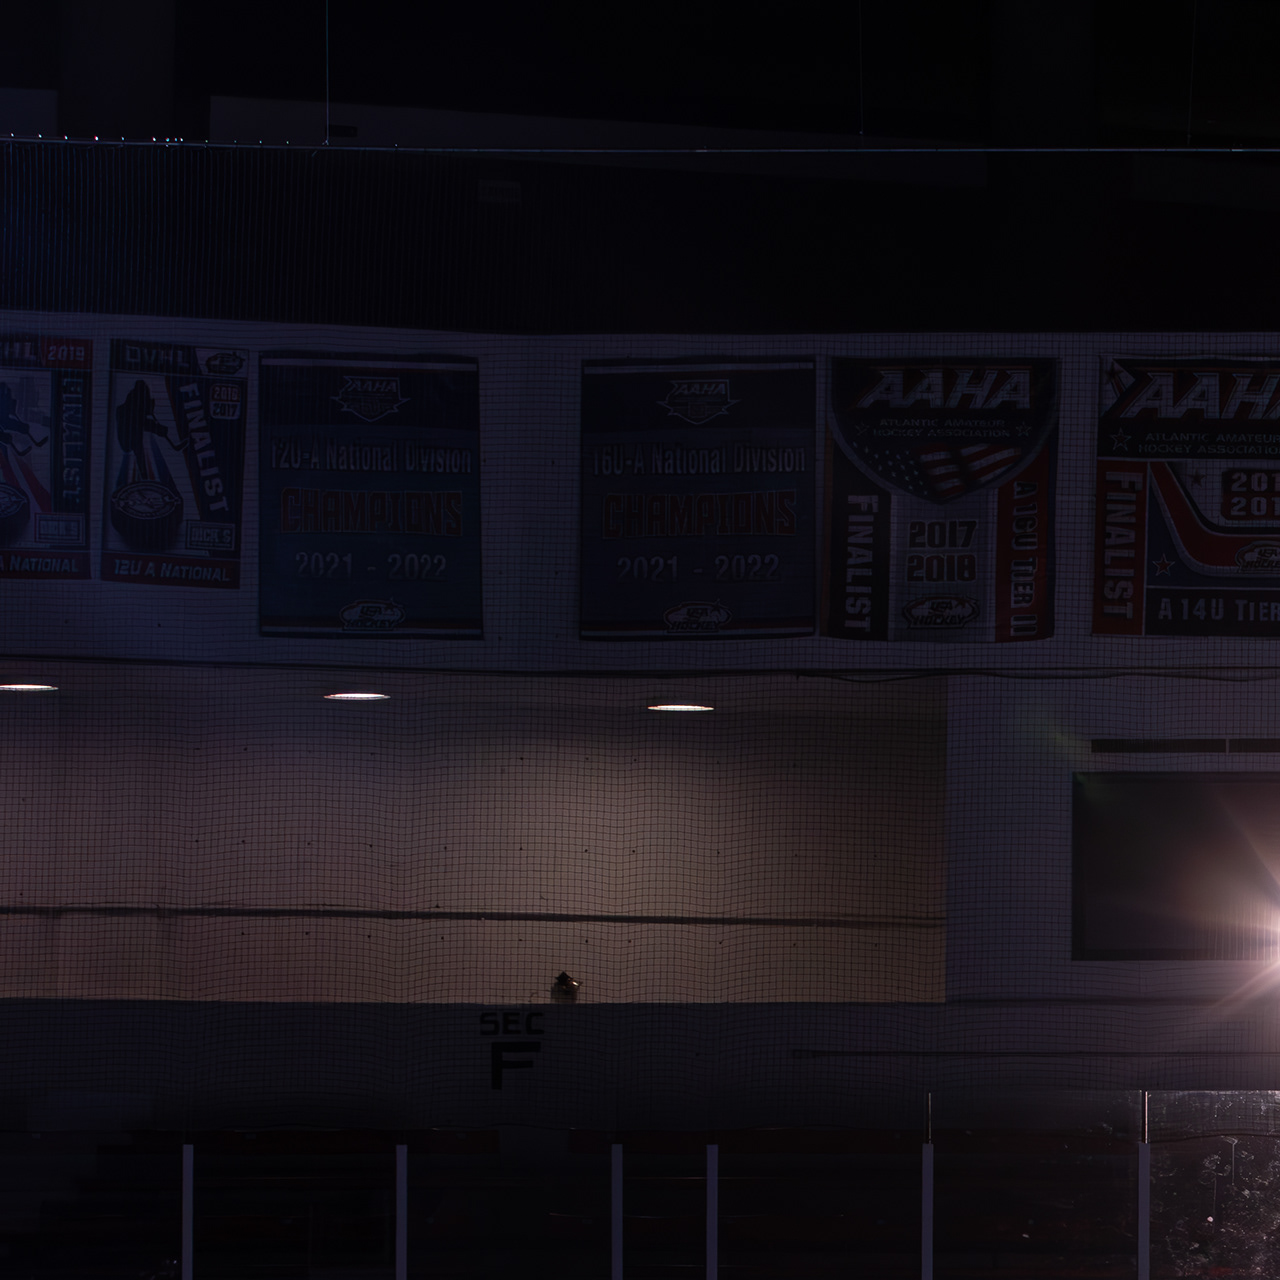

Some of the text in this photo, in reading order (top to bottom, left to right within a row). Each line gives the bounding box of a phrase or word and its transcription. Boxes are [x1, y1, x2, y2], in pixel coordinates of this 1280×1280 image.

[856, 368, 1031, 409] AAHA
[873, 429, 1011, 438] HOCKEY ASSOCIATION
[880, 419, 938, 427] ATLANTIC
[1145, 432, 1209, 442] ATLANTIC
[179, 381, 229, 514] FINALIST
[326, 440, 397, 472] National
[405, 444, 471, 473] Division
[594, 444, 805, 476] 16U-A National Division
[1138, 444, 1191, 454] HOCKEY
[1014, 481, 1038, 499] A
[281, 487, 462, 536] CHAMPIONS
[602, 489, 796, 539] CHAMPIONS
[909, 520, 977, 548] 2017
[1103, 472, 1144, 619] FINALIST
[10, 556, 80, 573] NATIONAL
[114, 558, 232, 582] 12U A NATIONAL
[295, 552, 447, 580] 2021 2022
[617, 554, 780, 582] 2021 2022
[844, 494, 879, 632] FINALIST
[907, 554, 976, 582] 2018
[1158, 599, 1173, 620] A
[1182, 599, 1224, 620] 14U
[1235, 600, 1280, 621] TIER
[480, 1012, 544, 1035] SEC
[492, 1041, 541, 1090] F
